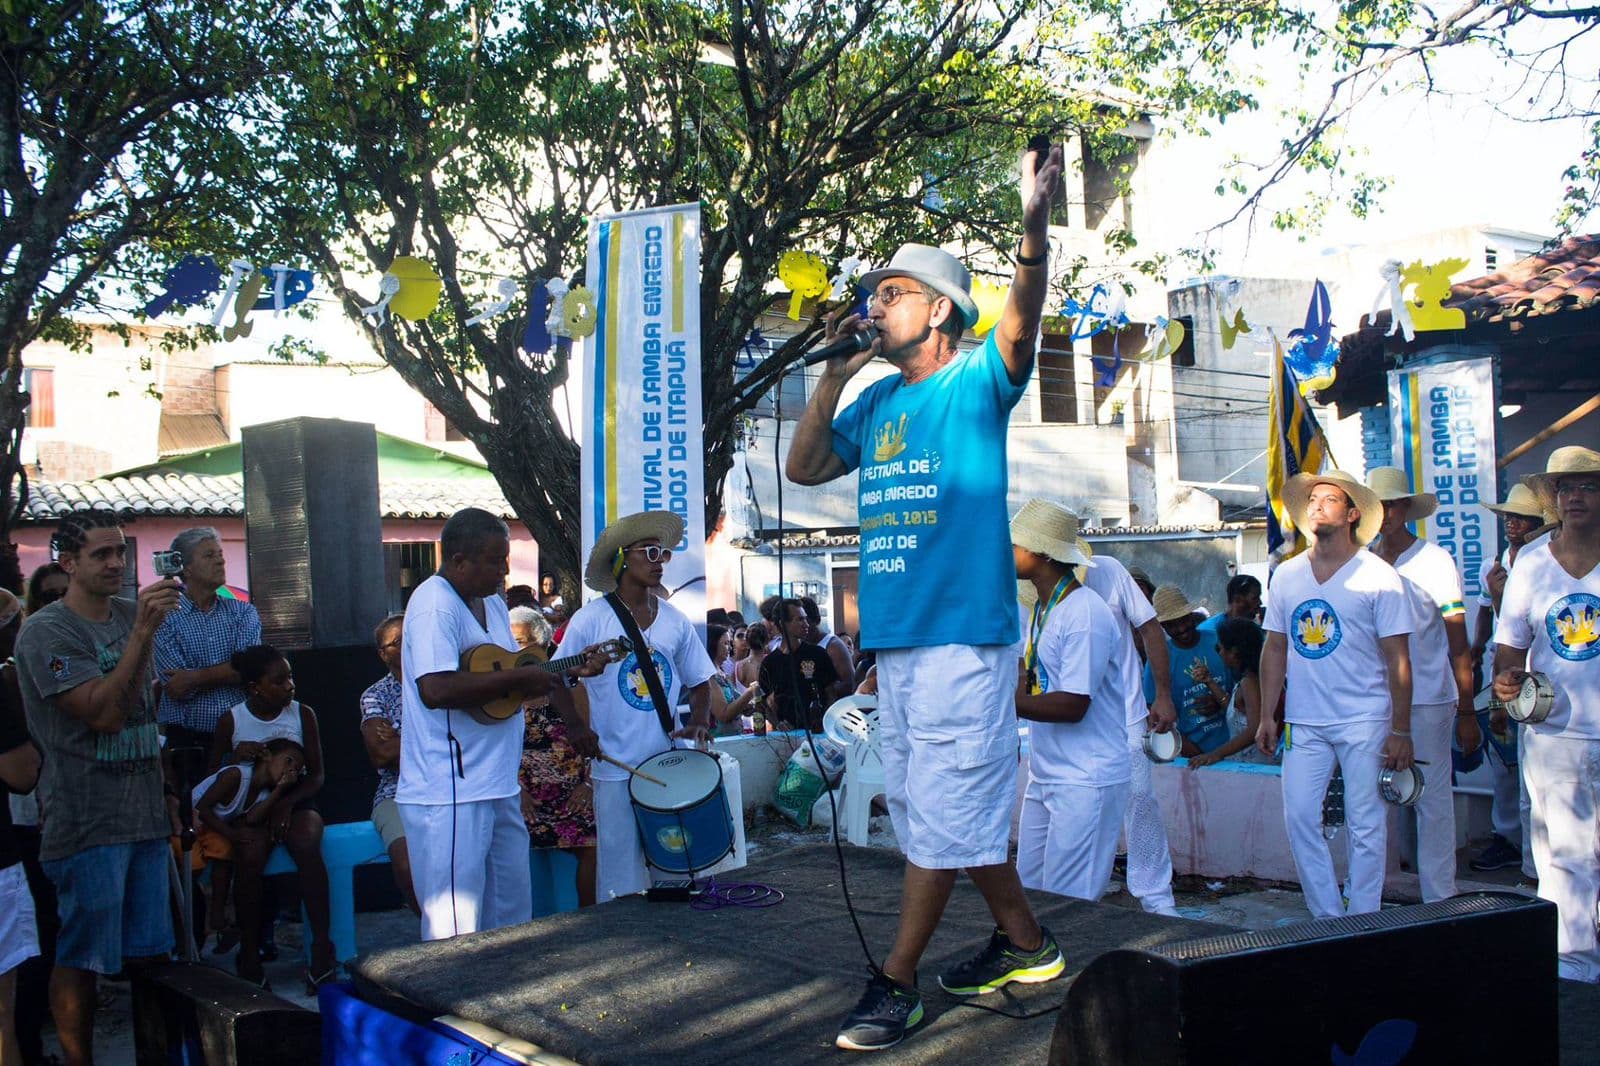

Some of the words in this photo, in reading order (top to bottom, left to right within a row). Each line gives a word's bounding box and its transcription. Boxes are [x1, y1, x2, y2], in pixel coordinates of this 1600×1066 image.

[644, 226, 662, 317] ENREDO
[643, 322, 661, 405] SAMBA
[665, 341, 686, 424] ITAPUÃ
[643, 412, 661, 442] DE
[1430, 386, 1452, 468] SAMBA
[668, 431, 686, 461] DE
[643, 448, 662, 513] TIVAL
[864, 460, 906, 481] FESTIVAL
[909, 459, 930, 474] DE
[884, 485, 937, 502] ENREDO
[1434, 475, 1454, 505] DE
[1458, 474, 1478, 504] DE
[902, 510, 938, 526] 2015
[897, 535, 918, 549] DE
[1436, 512, 1457, 558] OLA
[867, 556, 906, 577] ITAPUÃ
[1461, 511, 1482, 596] UNIDOS
